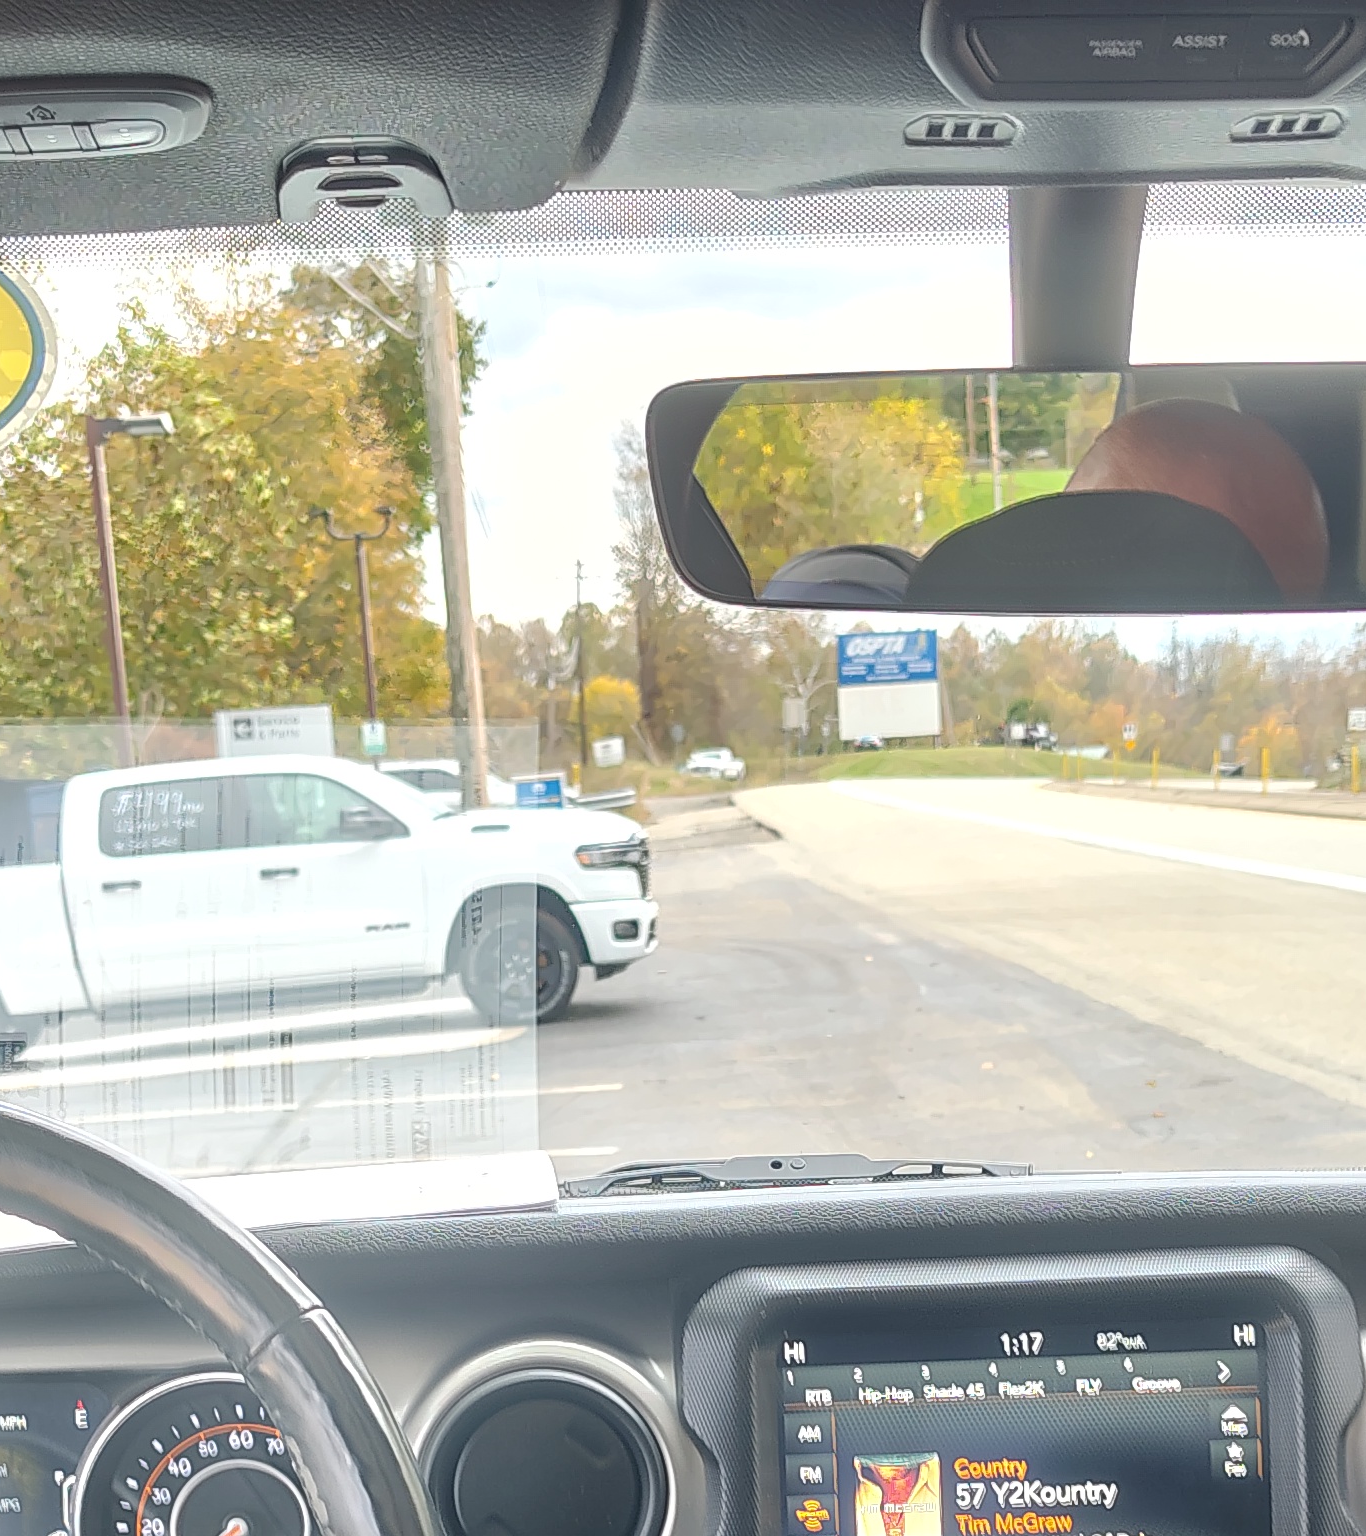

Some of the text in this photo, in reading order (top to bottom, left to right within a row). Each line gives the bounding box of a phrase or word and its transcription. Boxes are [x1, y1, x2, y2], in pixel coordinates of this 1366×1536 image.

[1171, 34, 1228, 48] ASSIST
[1269, 33, 1300, 47] SOS
[1000, 1331, 1044, 1356] 1:17
[1233, 1324, 1256, 1347] HI
[784, 1341, 806, 1364] HI
[853, 1367, 864, 1383] 2
[921, 1365, 931, 1380] 3
[923, 1382, 985, 1402] Shade 45
[1076, 1378, 1102, 1396] FLY
[1131, 1376, 1182, 1394] Groove
[858, 1386, 915, 1406] Hip-Hop
[0, 1414, 28, 1431] MPH
[228, 1429, 254, 1450] 60
[798, 1425, 822, 1443] AM
[198, 1439, 218, 1458] 50
[266, 1437, 285, 1456] 70
[167, 1456, 192, 1478] 40
[800, 1466, 822, 1484] FM
[954, 1457, 1028, 1480] Country
[151, 1487, 172, 1506] 30
[955, 1480, 1118, 1509] 57 Y2Kountry
[955, 1512, 1073, 1536] Tim McGraw
